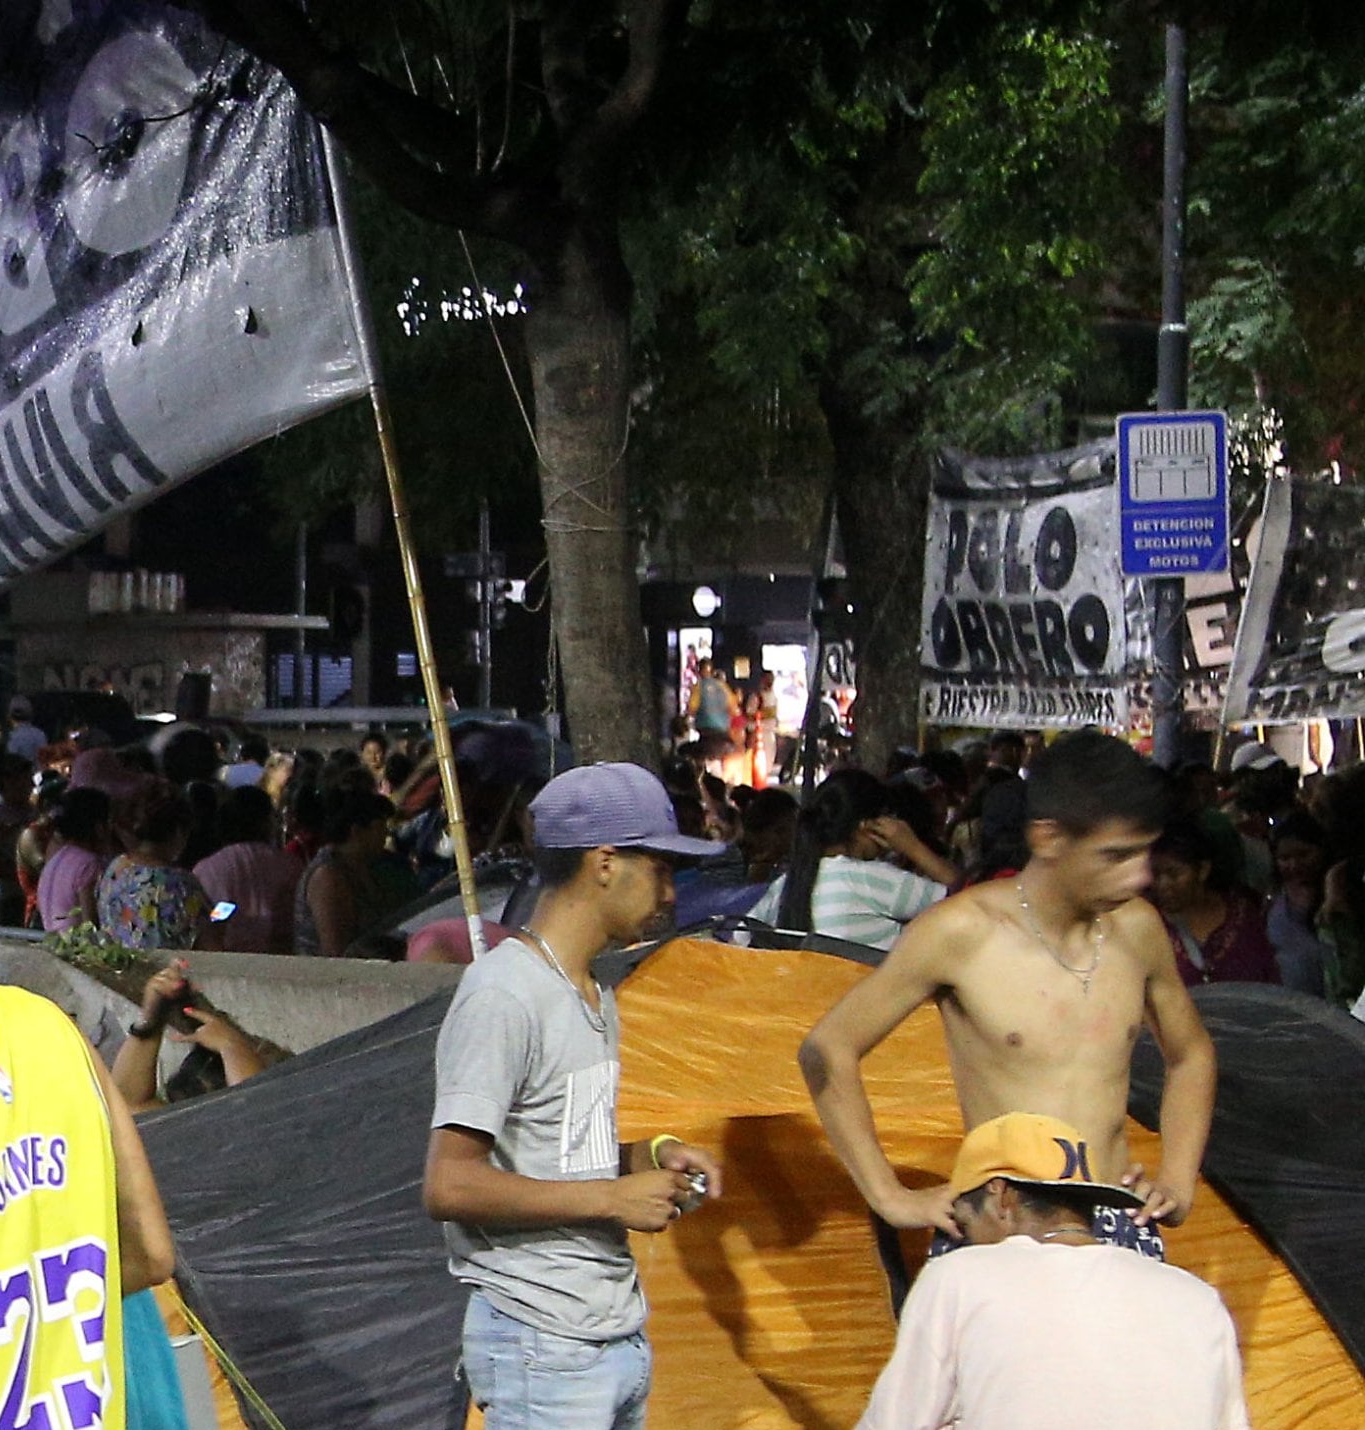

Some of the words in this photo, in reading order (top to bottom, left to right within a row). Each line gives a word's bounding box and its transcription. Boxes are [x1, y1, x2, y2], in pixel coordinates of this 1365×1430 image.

[944, 506, 1078, 596] POLO
[1134, 535, 1213, 551] EXCLUSIVA
[1149, 554, 1199, 568] MOTOS
[931, 593, 1111, 676] OBRERO
